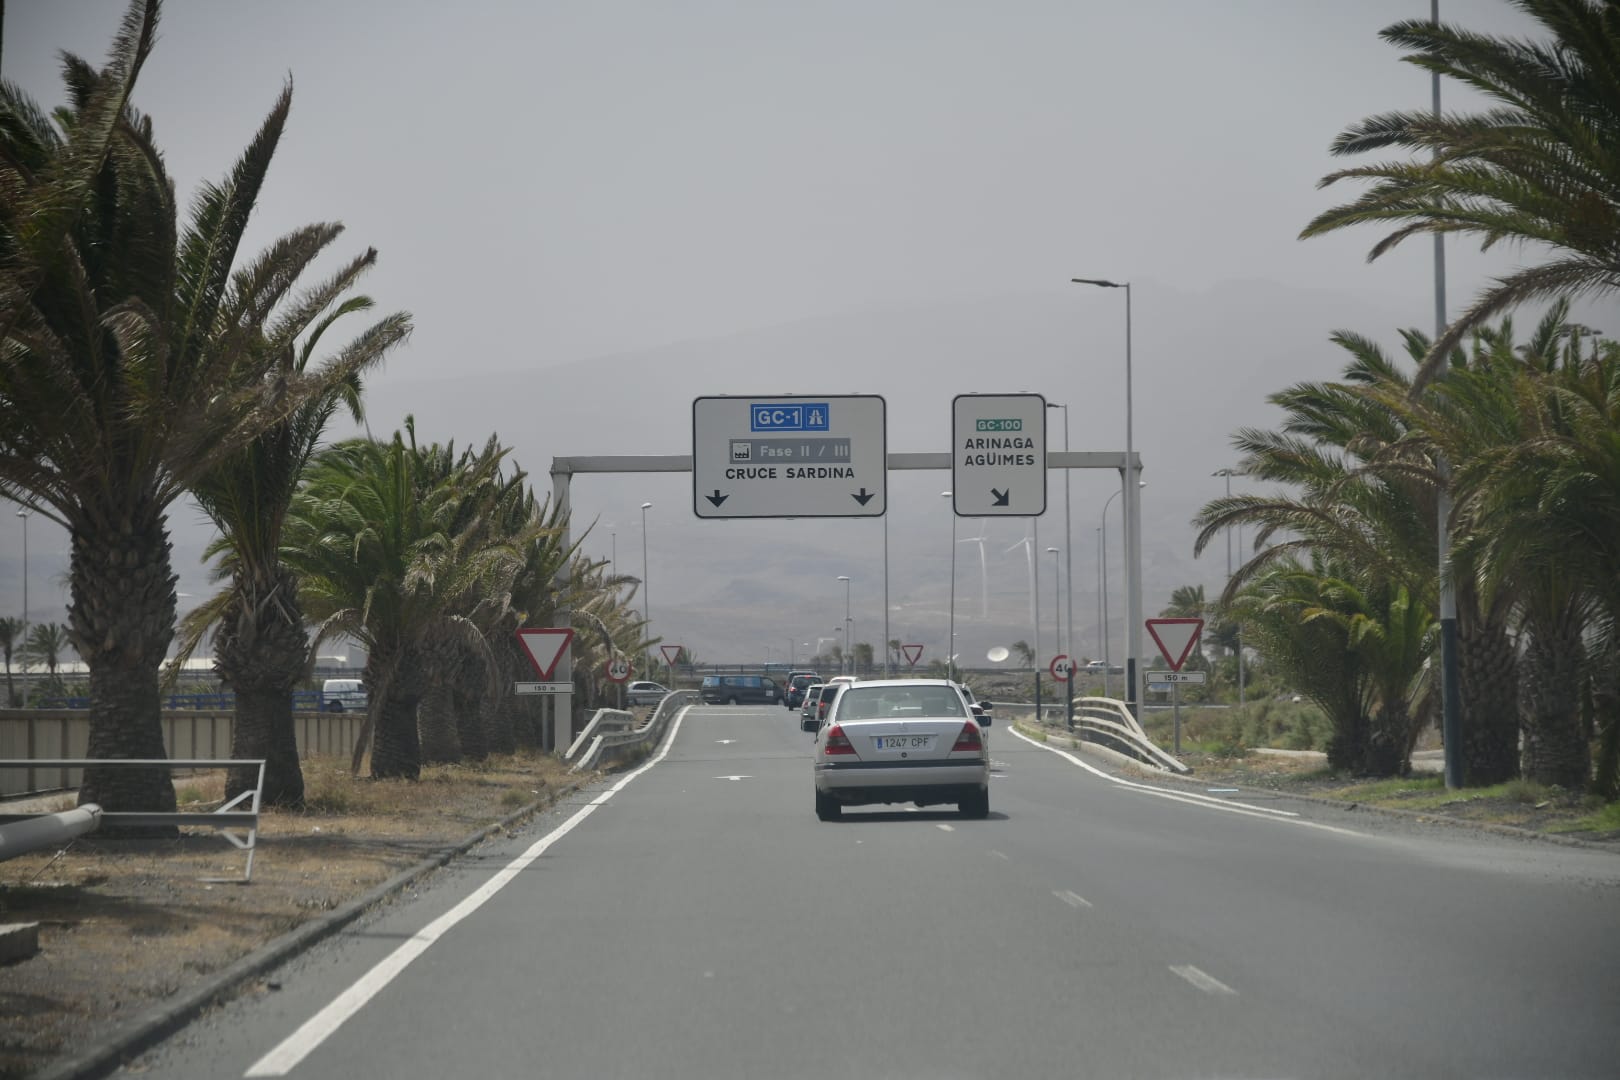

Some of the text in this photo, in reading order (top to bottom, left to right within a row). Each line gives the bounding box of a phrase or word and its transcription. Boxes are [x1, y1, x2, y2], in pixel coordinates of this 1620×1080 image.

[758, 411, 799, 424] GC-1
[978, 421, 1020, 430] GC-100
[965, 438, 1034, 449] ARINAGA
[760, 445, 793, 457] Fase
[965, 452, 1035, 465] AGÜIMES
[725, 467, 855, 479] CRUCE SARDINA
[611, 665, 627, 674] 40
[885, 737, 929, 748] 1247 CPF
